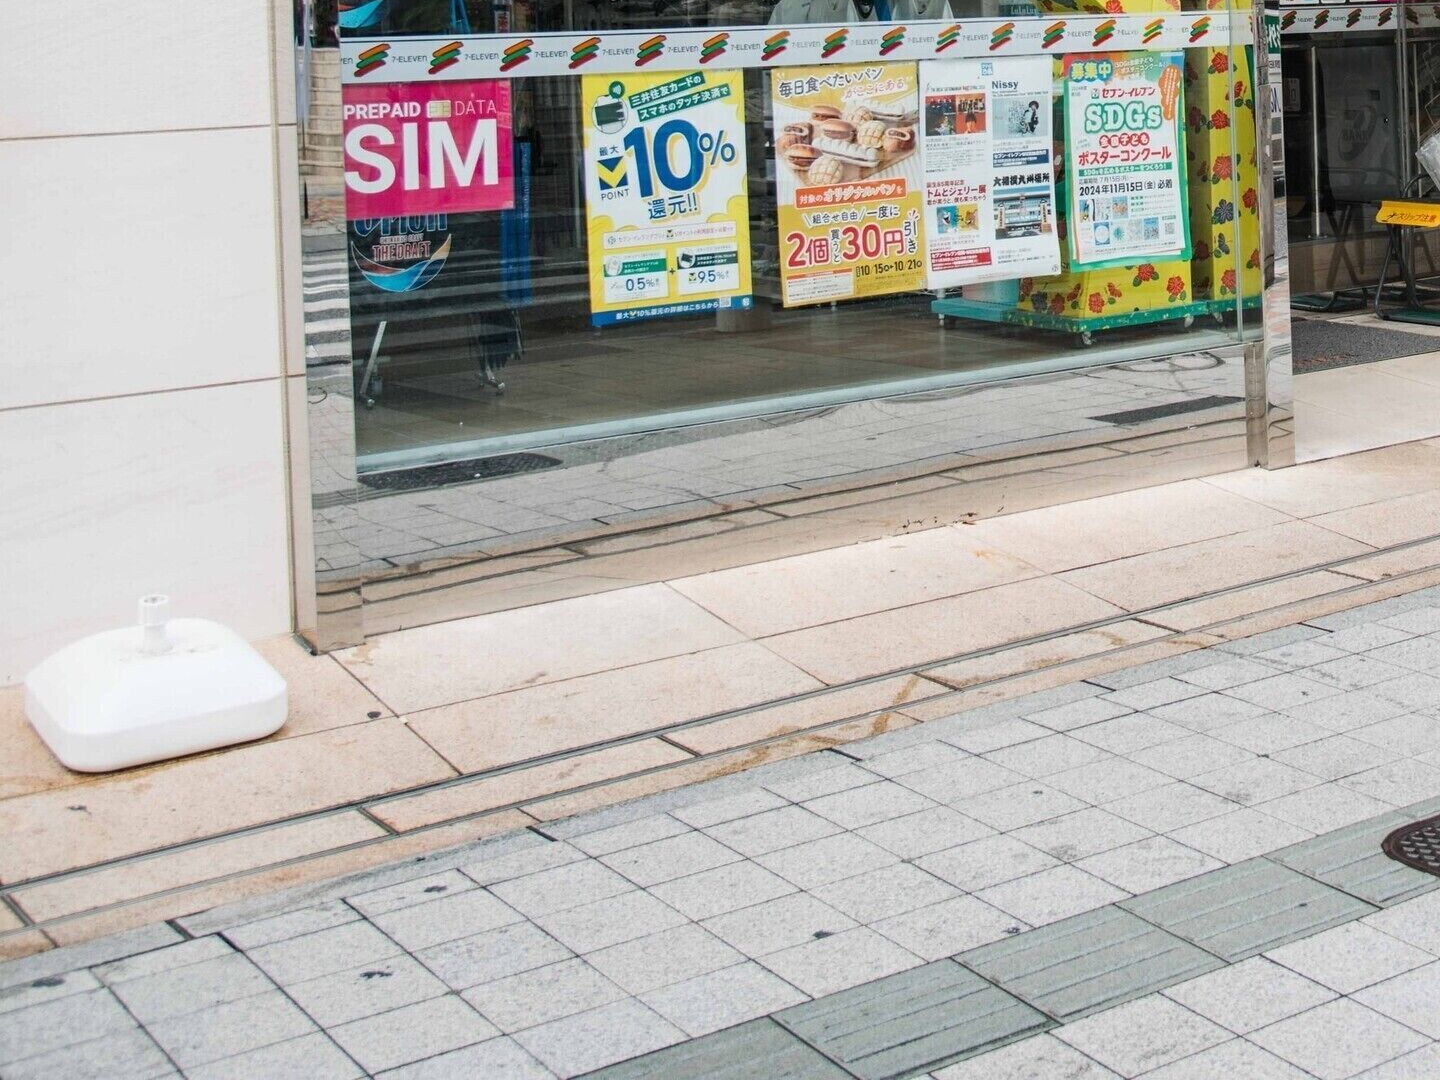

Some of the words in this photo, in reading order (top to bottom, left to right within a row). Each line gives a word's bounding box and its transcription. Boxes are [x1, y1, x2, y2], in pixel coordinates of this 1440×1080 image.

[631, 74, 701, 106] 三井住友カードの
[779, 67, 883, 98] 毎日食べたいパン
[991, 80, 1018, 90] Nissy
[344, 101, 421, 120] PREPAID
[454, 99, 497, 116] DATA
[639, 86, 730, 119] スマホのタッチ決済で
[1084, 101, 1162, 133] SDGs
[344, 118, 499, 194] SIM
[599, 145, 619, 156] 最大
[623, 119, 736, 198] 10%
[1078, 146, 1171, 166] ポスターコンクール
[601, 188, 630, 200] POINT
[927, 184, 986, 198] トムとジェリー展
[1157, 179, 1173, 189] 必着
[867, 205, 899, 219] 一度に
[786, 232, 829, 267] 2個
[842, 224, 904, 260] 30円
[904, 220, 918, 253] 引き
